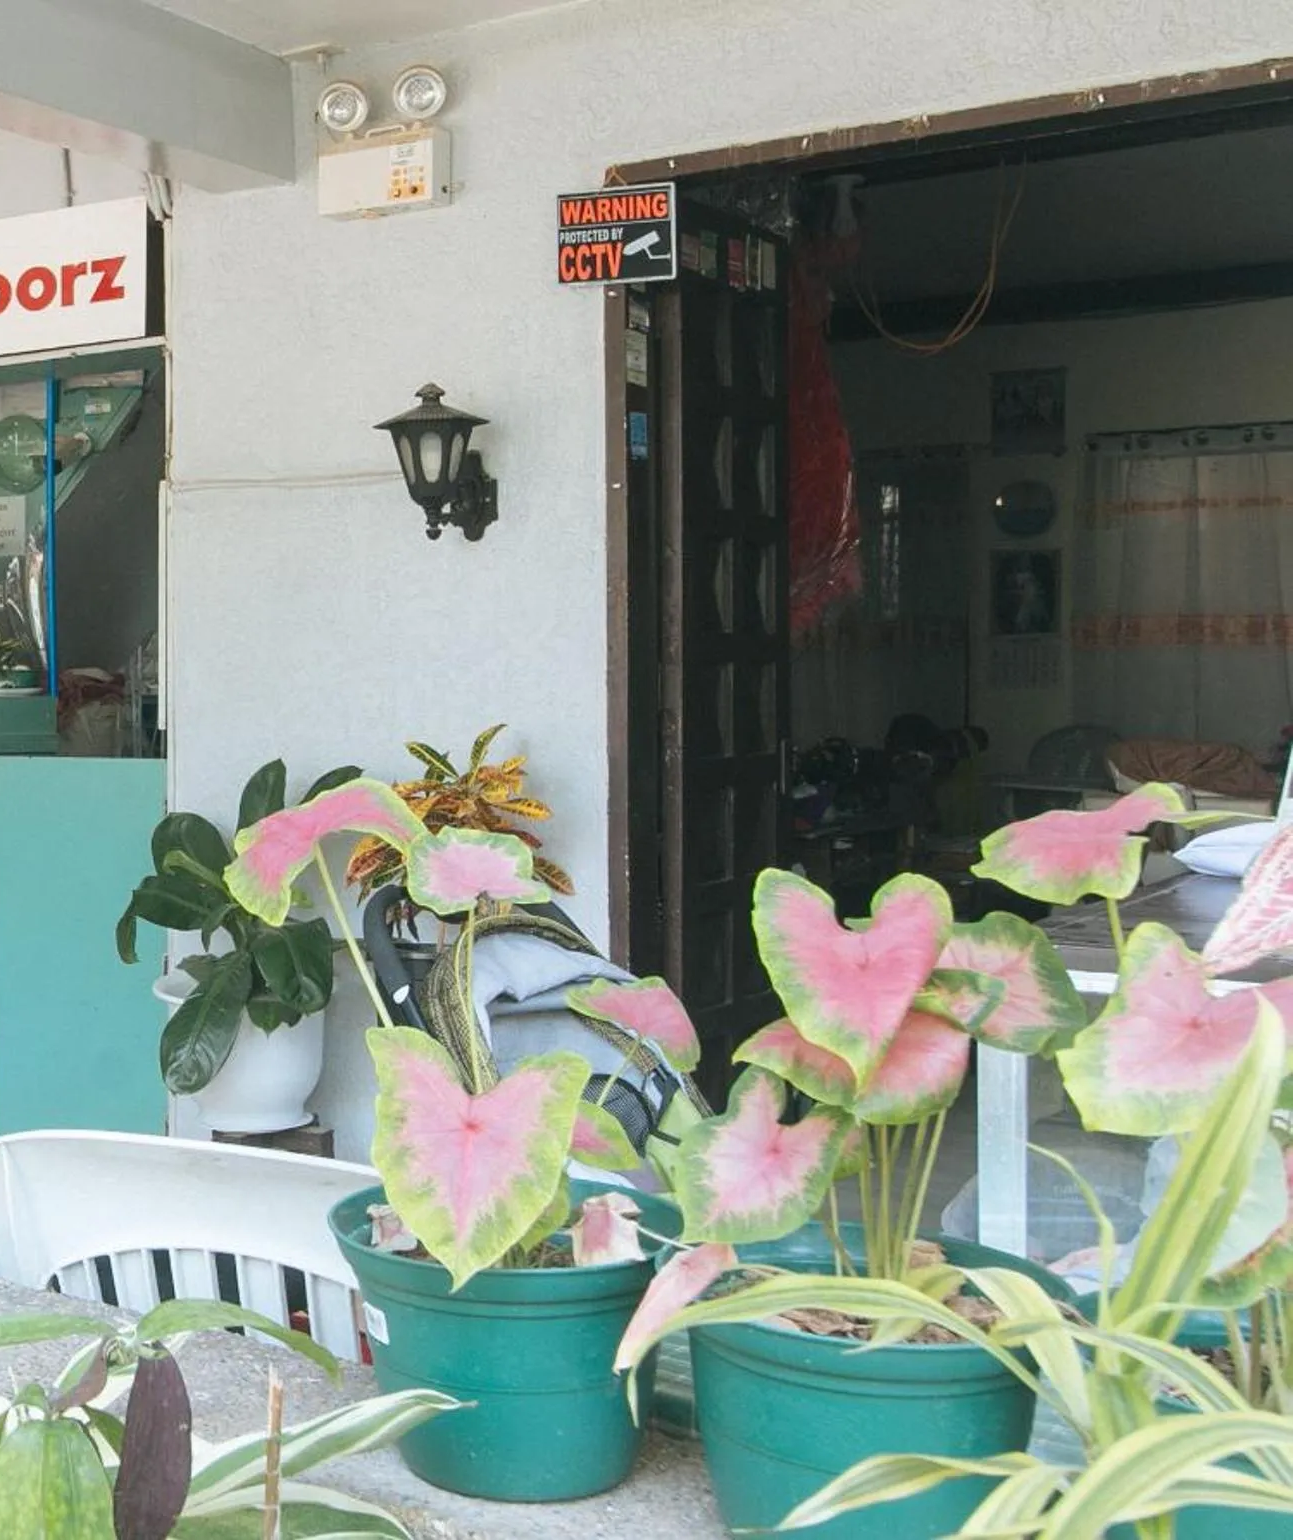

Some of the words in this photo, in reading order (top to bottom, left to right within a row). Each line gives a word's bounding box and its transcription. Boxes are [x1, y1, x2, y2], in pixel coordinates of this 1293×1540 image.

[561, 193, 668, 224] WARNING
[559, 229, 609, 244] PROTECTED
[611, 227, 624, 240] BY
[560, 242, 623, 282] CCTV
